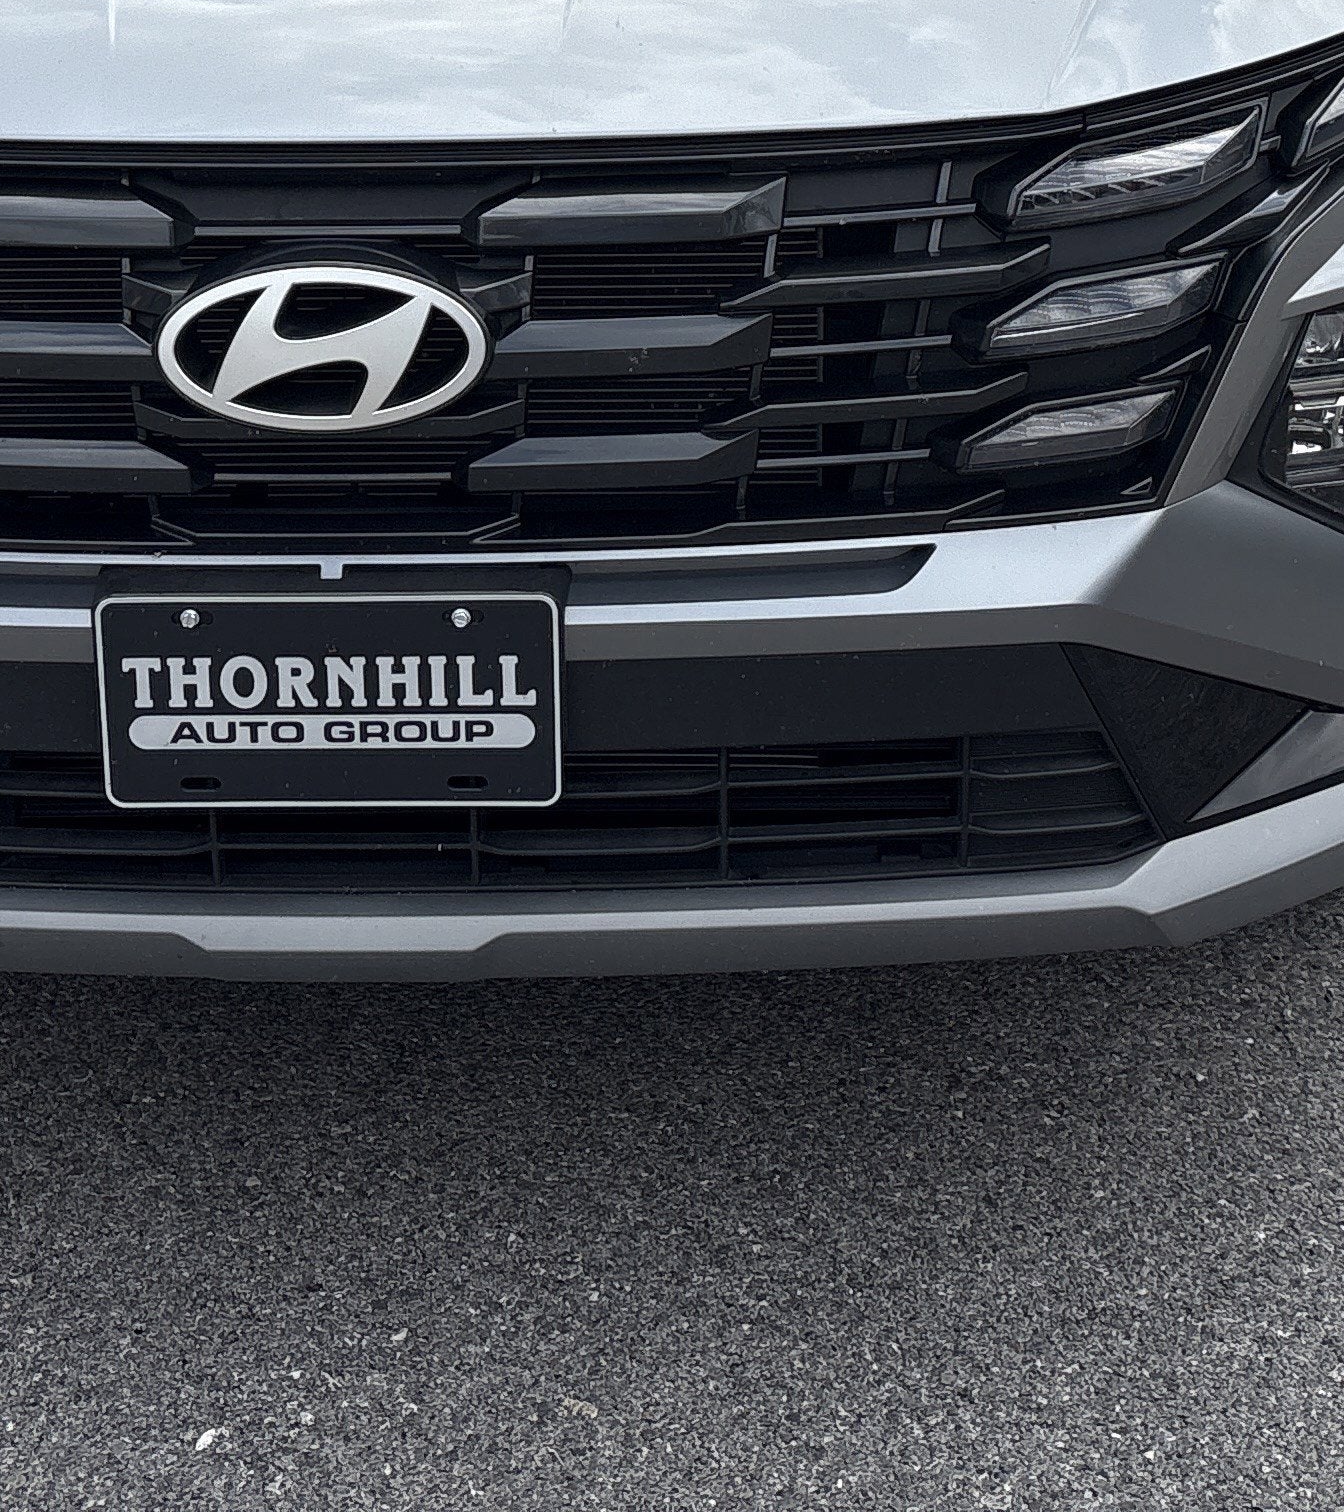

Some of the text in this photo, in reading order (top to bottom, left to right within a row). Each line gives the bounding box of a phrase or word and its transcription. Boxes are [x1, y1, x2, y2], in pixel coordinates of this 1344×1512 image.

[121, 655, 537, 709] THORNHILL
[169, 720, 494, 744] AUTO GROUP
